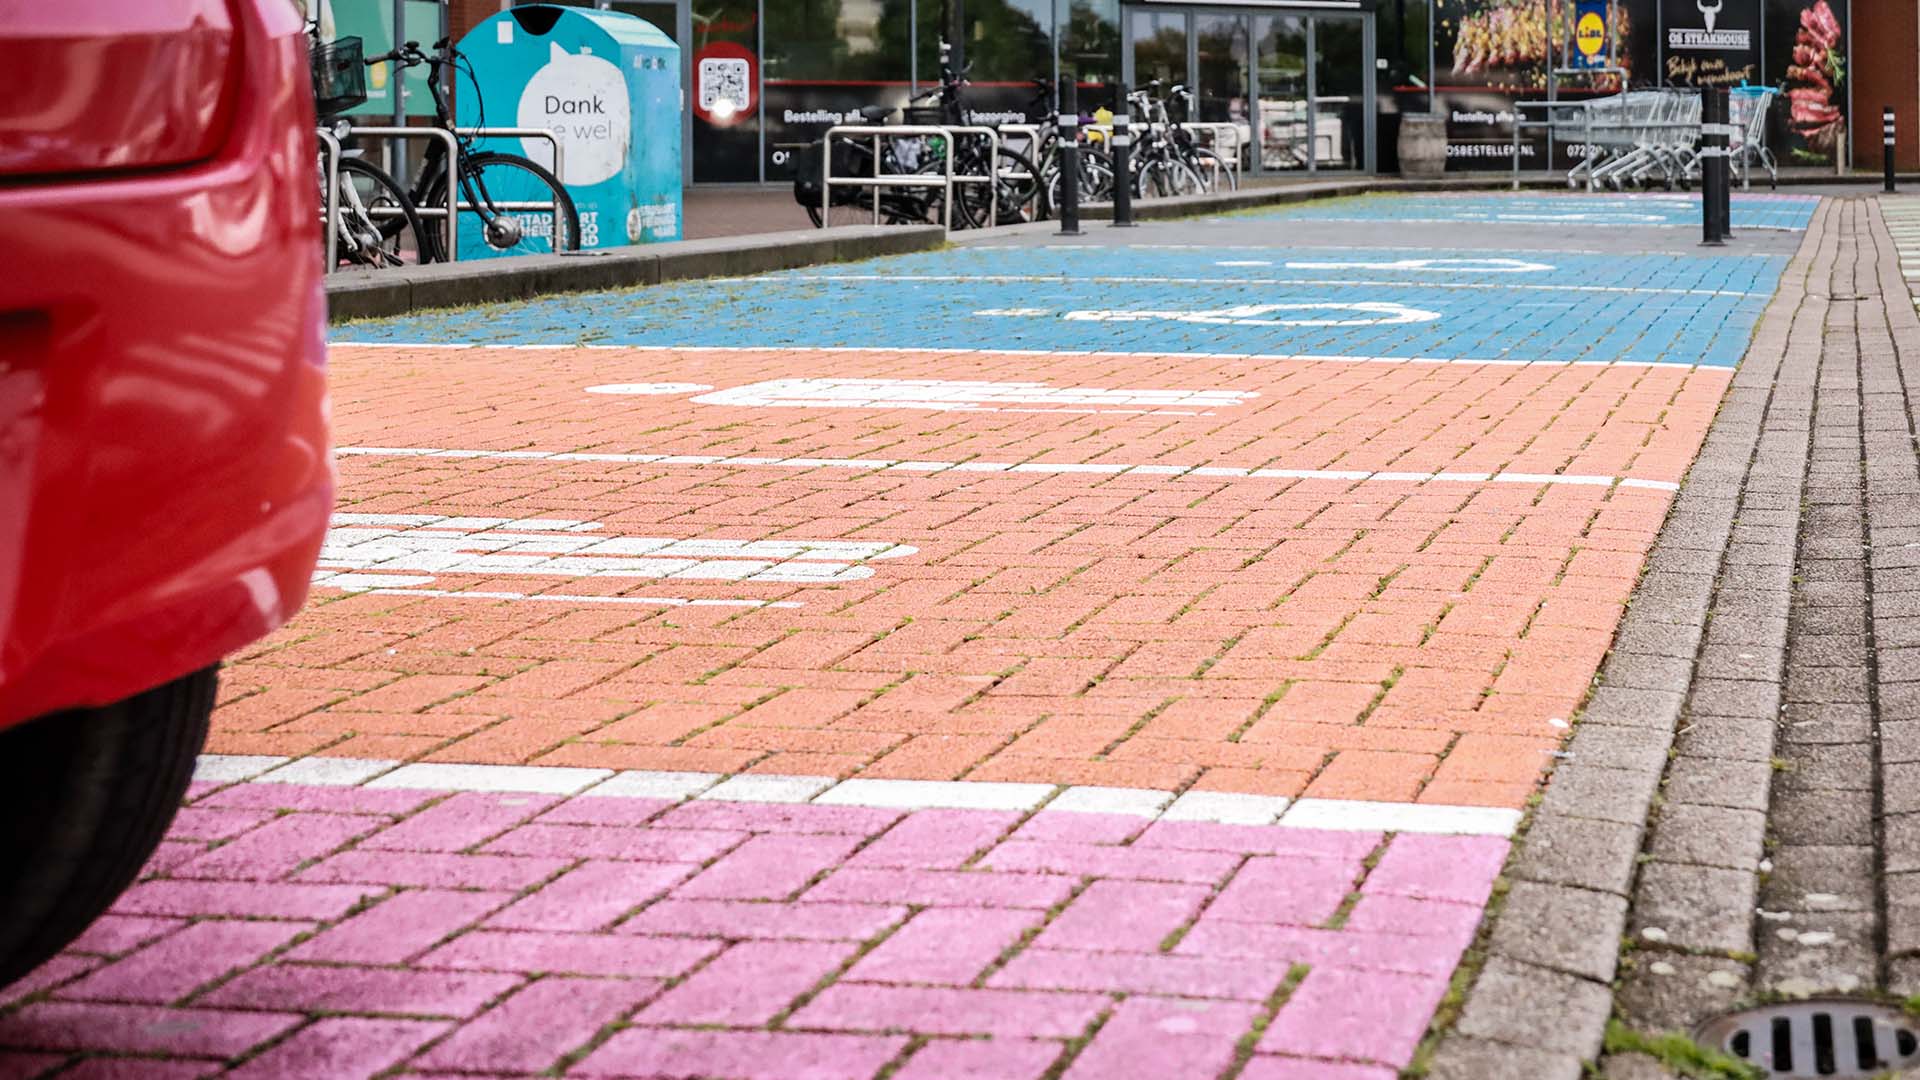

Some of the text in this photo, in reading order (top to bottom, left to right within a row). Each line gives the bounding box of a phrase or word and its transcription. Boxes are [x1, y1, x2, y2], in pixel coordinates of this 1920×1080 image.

[1669, 32, 1750, 46] OS STEAKHOUSE
[545, 95, 605, 114] Dank
[784, 109, 842, 125] Bestelling
[971, 109, 1026, 124] bezorging
[1452, 110, 1494, 125] Bestelling
[573, 119, 612, 140] wel
[1446, 144, 1535, 157] OSBESTELLENL
